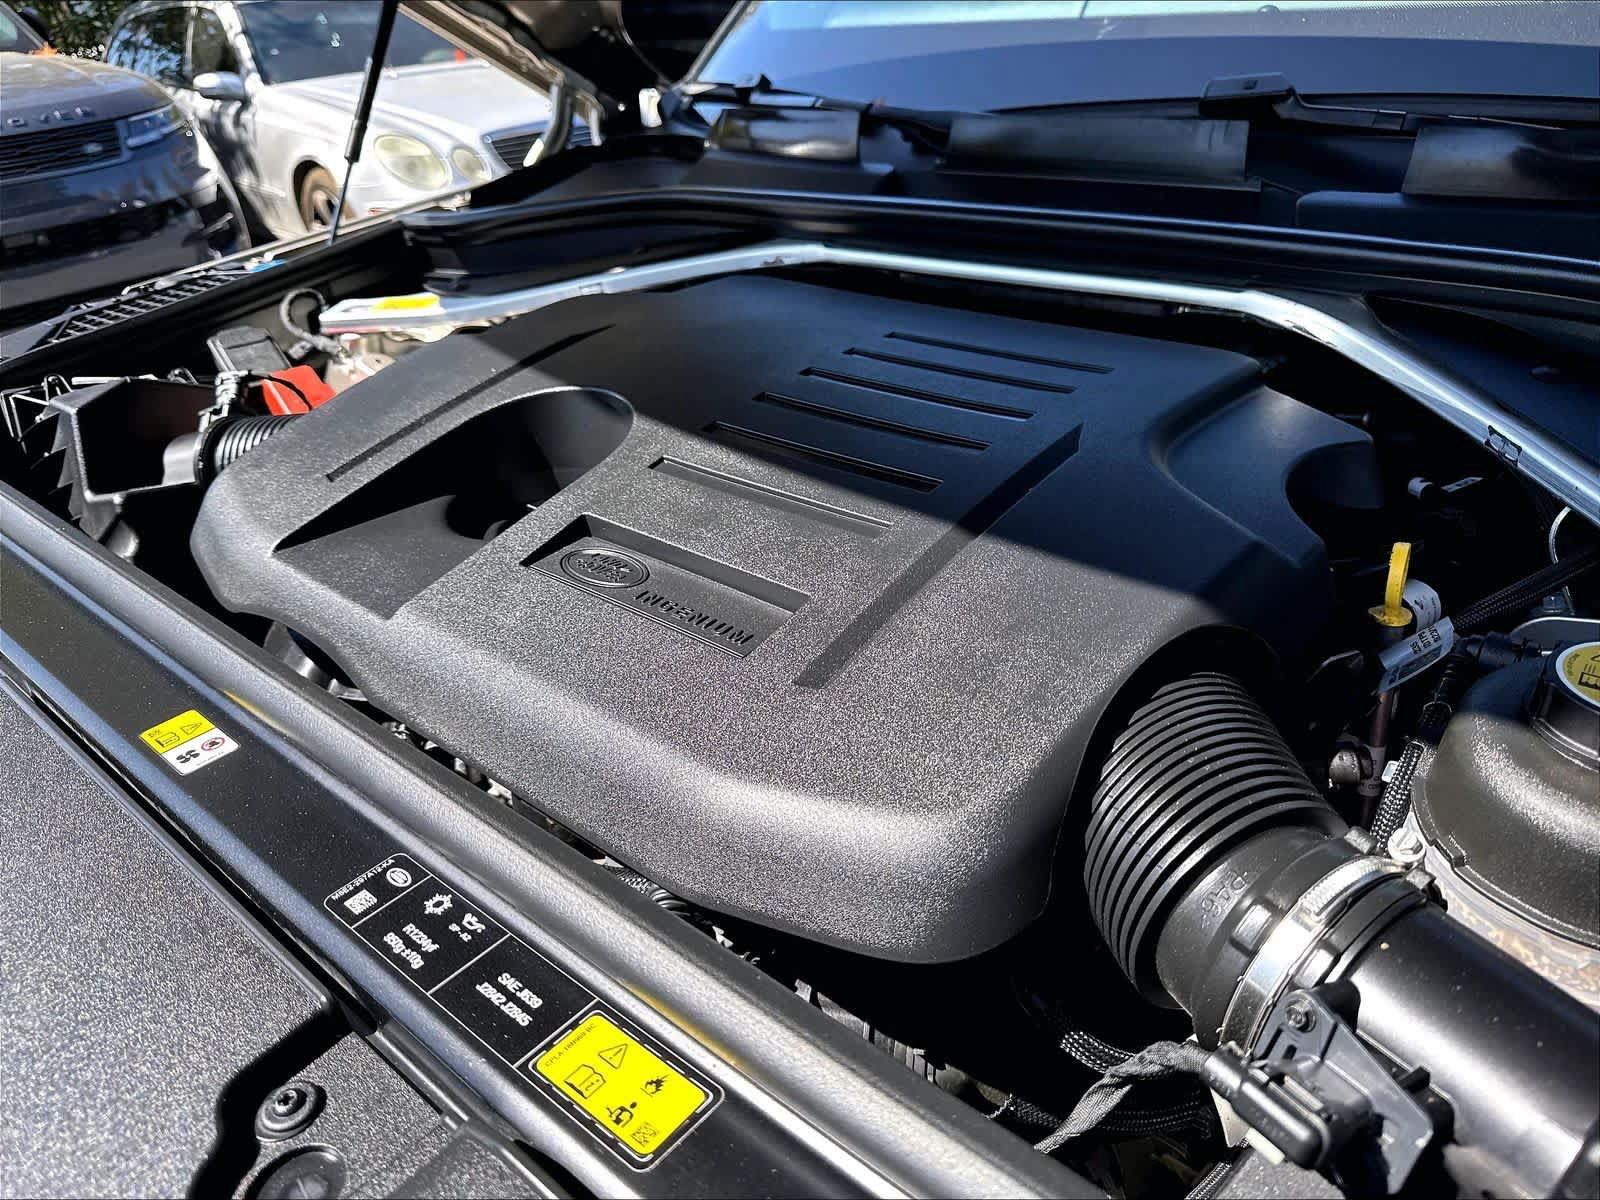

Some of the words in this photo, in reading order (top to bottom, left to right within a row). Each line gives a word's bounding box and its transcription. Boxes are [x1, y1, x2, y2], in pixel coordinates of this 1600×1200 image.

[634, 589, 756, 646] INGENIUM
[402, 923, 440, 953] R1234yf
[476, 981, 504, 1007] J2842
[500, 1001, 533, 1027] J2845
[497, 972, 523, 994] SAE
[515, 987, 543, 1009] J639
